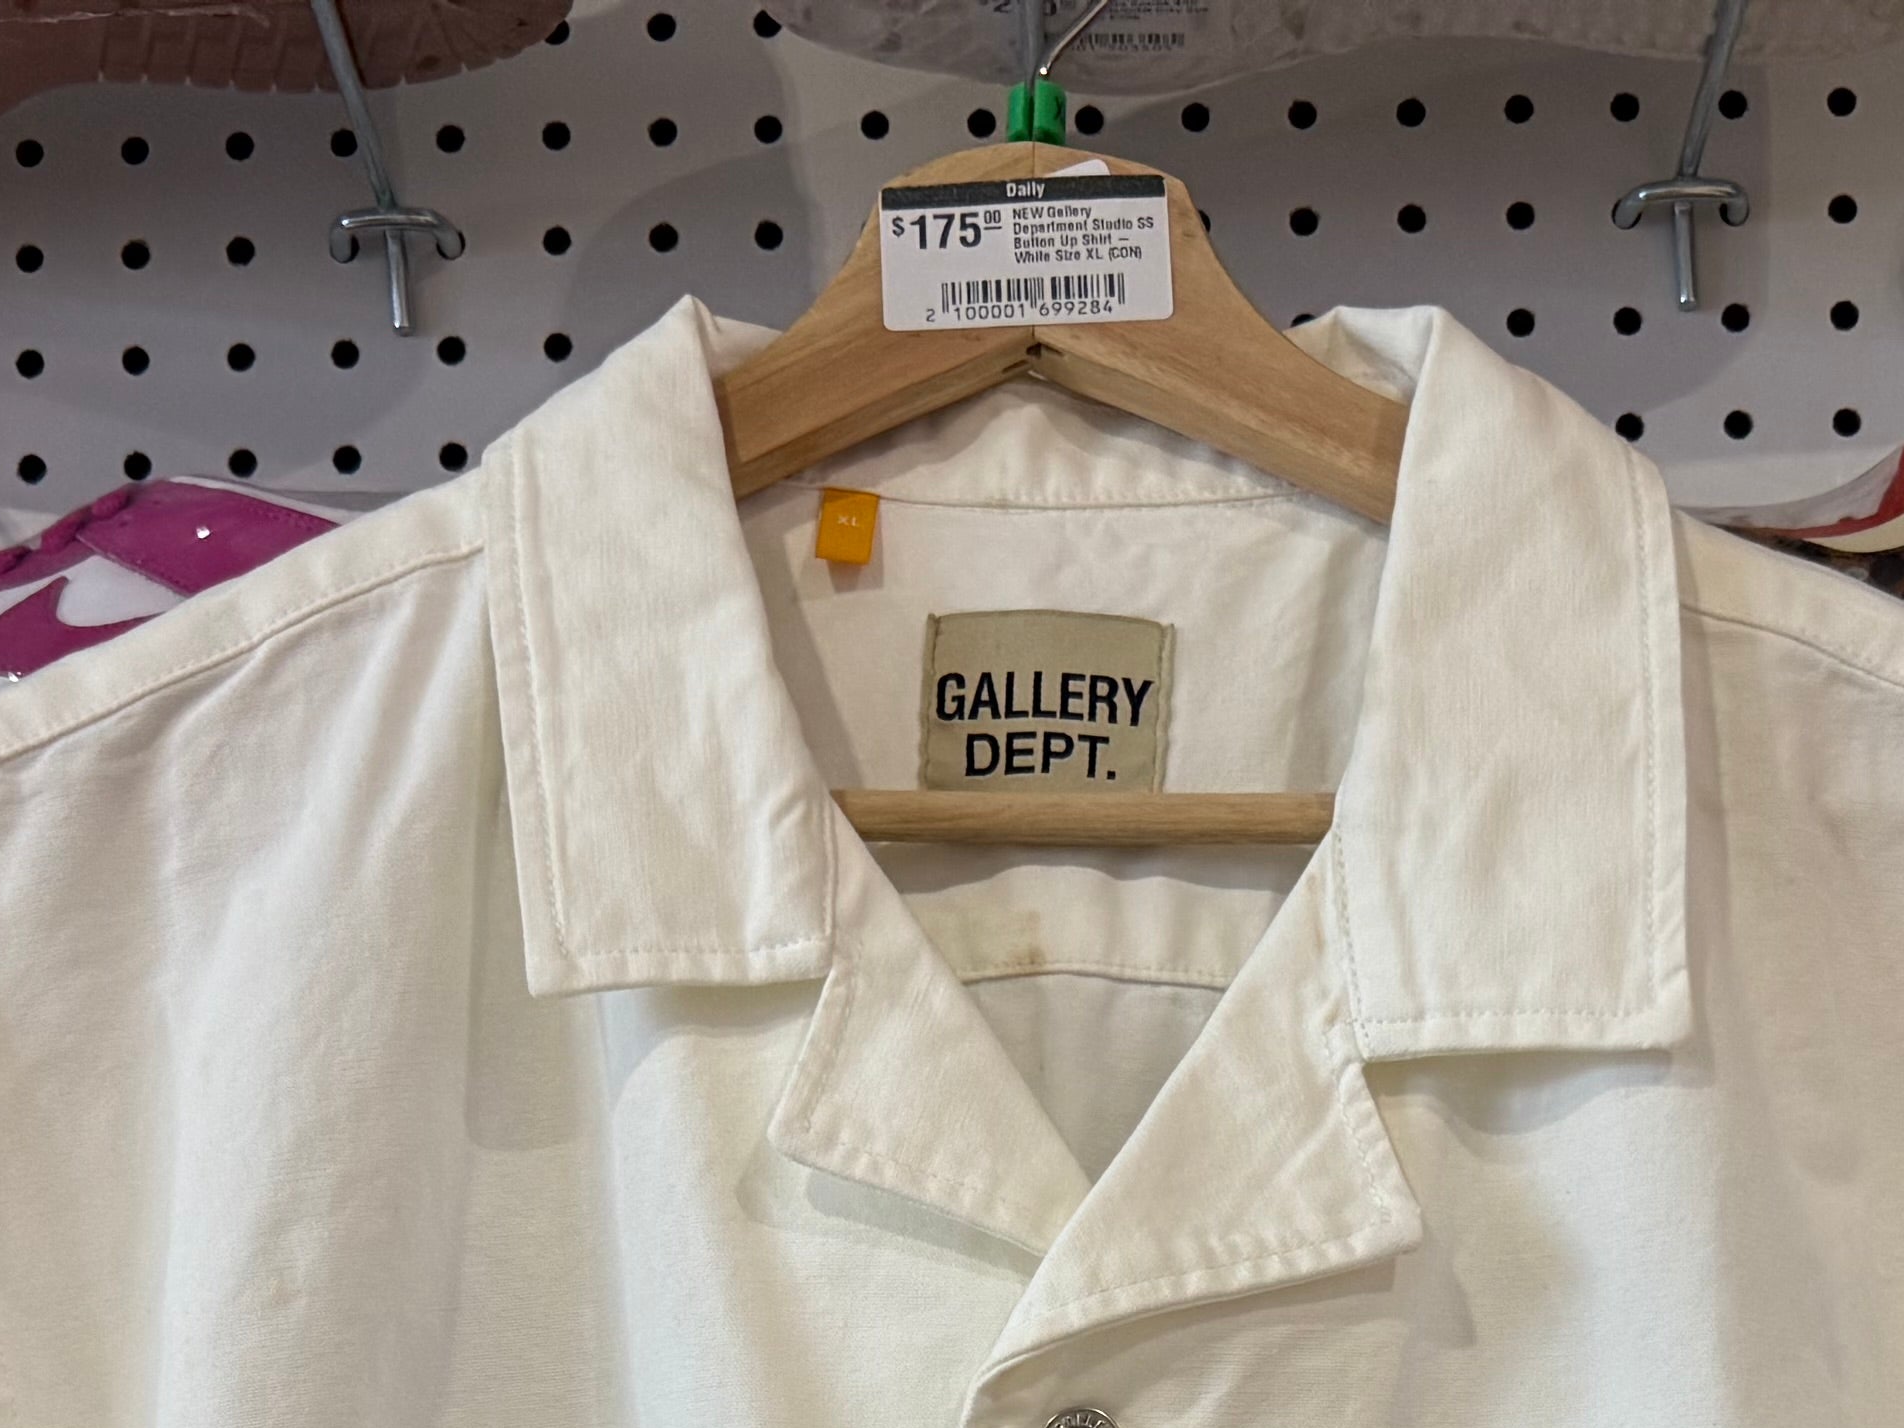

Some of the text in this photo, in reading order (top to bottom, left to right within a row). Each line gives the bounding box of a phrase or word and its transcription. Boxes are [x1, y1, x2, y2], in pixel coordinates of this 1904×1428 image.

[1006, 181, 1046, 199] Daily
[1012, 205, 1092, 220] NEW Gallery
[1013, 216, 1154, 236] Department Studio SS
[1014, 236, 1055, 250] Button
[1060, 234, 1078, 249] Up
[1081, 233, 1112, 246] Shirt
[1014, 246, 1142, 264] White Size XL (CON)
[954, 304, 1026, 321] 100001
[1039, 300, 1114, 318] 699284
[935, 670, 1155, 728] GALLERY
[965, 731, 1117, 781] DEPT.
